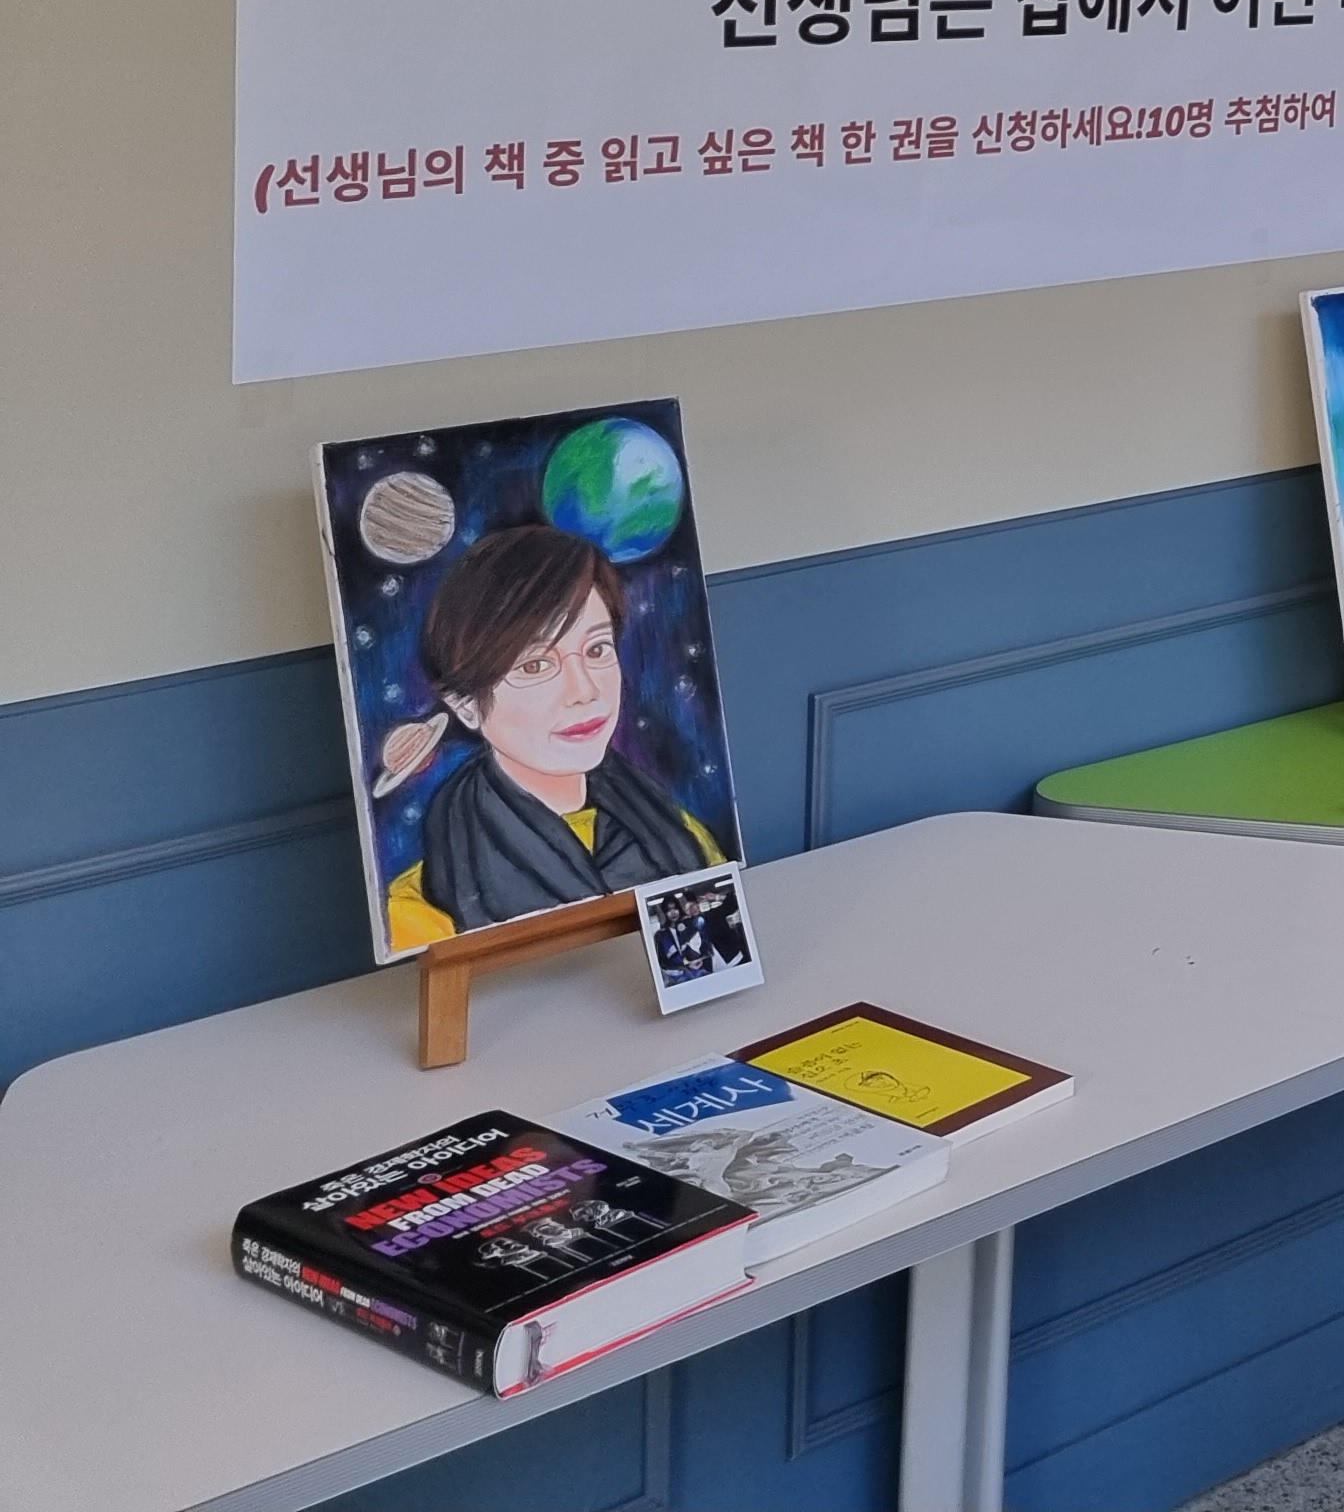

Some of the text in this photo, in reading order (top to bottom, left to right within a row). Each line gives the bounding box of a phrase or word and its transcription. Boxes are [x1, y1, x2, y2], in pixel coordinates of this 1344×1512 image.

[254, 144, 467, 214] (선생님의
[484, 141, 527, 192] 책
[543, 138, 584, 187] 중
[600, 133, 682, 185] 읽고
[697, 127, 777, 175] 싶은
[789, 123, 827, 169] 책
[840, 119, 877, 163] 한
[889, 115, 960, 162] 권을
[1224, 95, 1337, 138] 추첨하여
[636, 1074, 773, 1136] 세계사
[301, 1127, 510, 1213] 살아있는 아이디어
[343, 1188, 440, 1232] NEW
[434, 1145, 549, 1194] IDEAS
[370, 1157, 609, 1258] ECONOMISTS
[386, 1194, 475, 1233] FROM
[469, 1163, 551, 1199] DEAD
[283, 1275, 324, 1308] 아이디어
